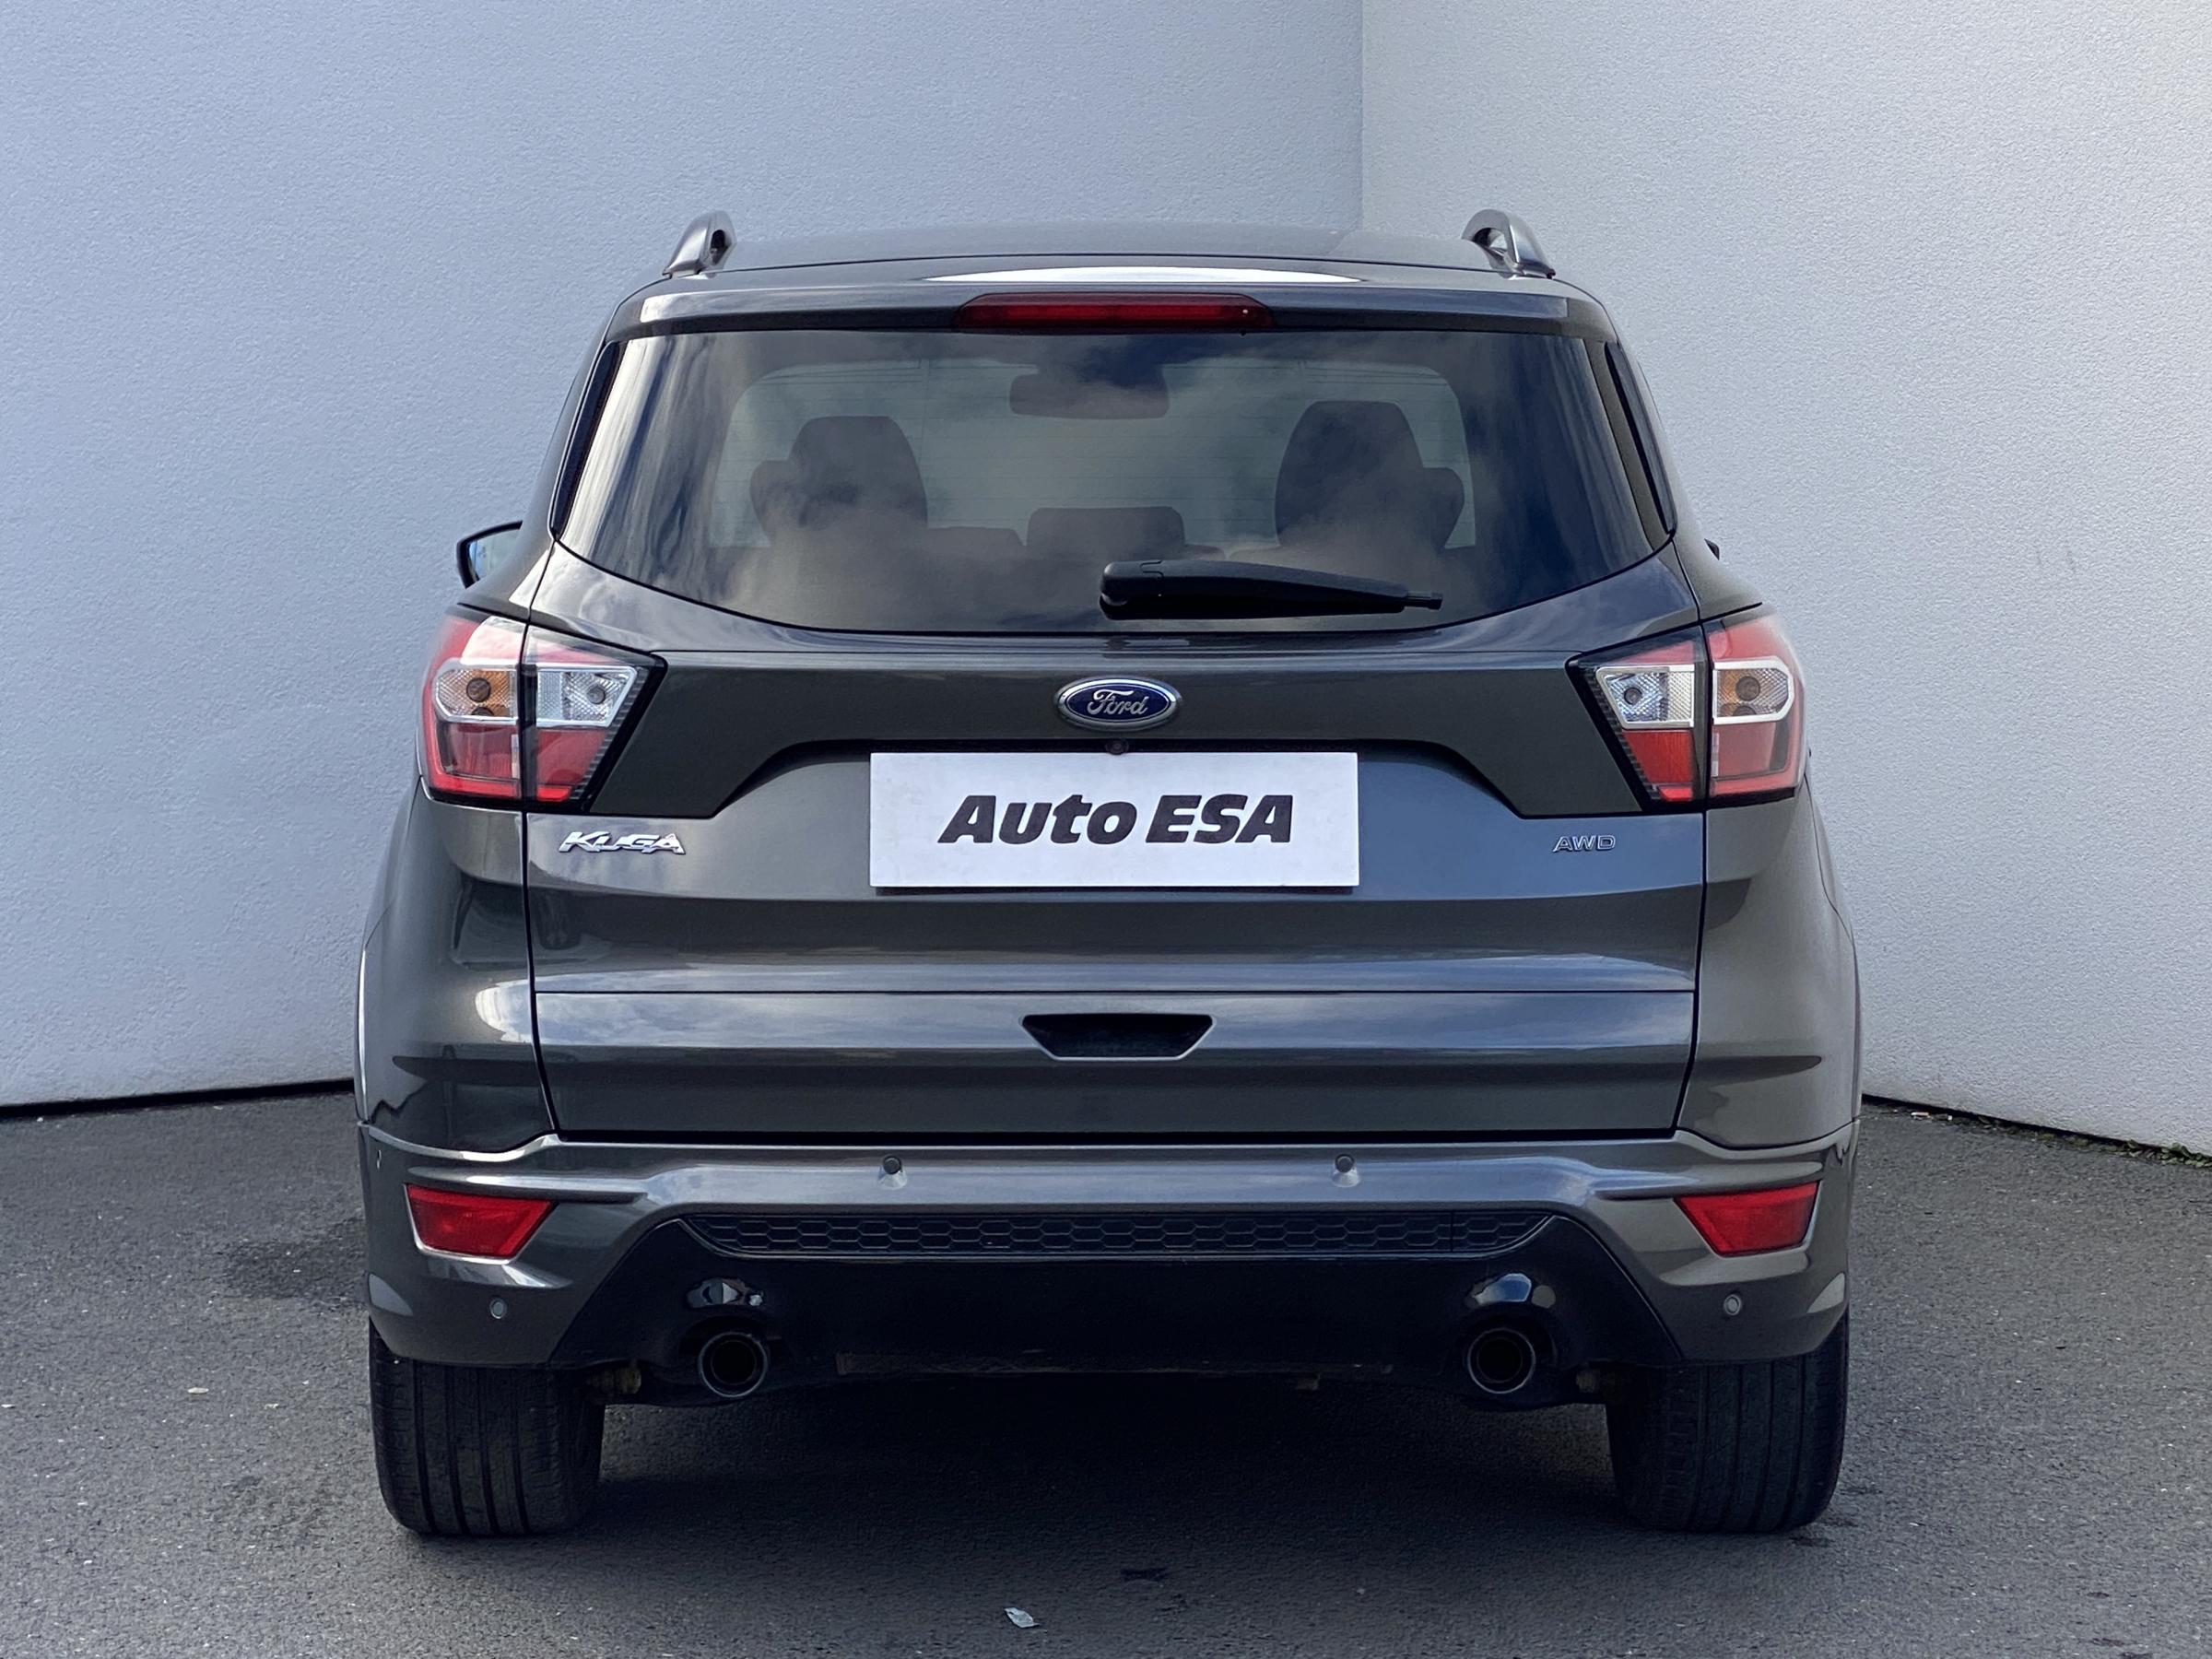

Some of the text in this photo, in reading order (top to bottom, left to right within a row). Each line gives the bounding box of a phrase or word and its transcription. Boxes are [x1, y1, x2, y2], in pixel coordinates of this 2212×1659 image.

[1087, 688, 1148, 716] Ford
[936, 794, 1294, 845] Auto ESA
[558, 830, 687, 855] KUGA
[1552, 834, 1617, 853] AWD
